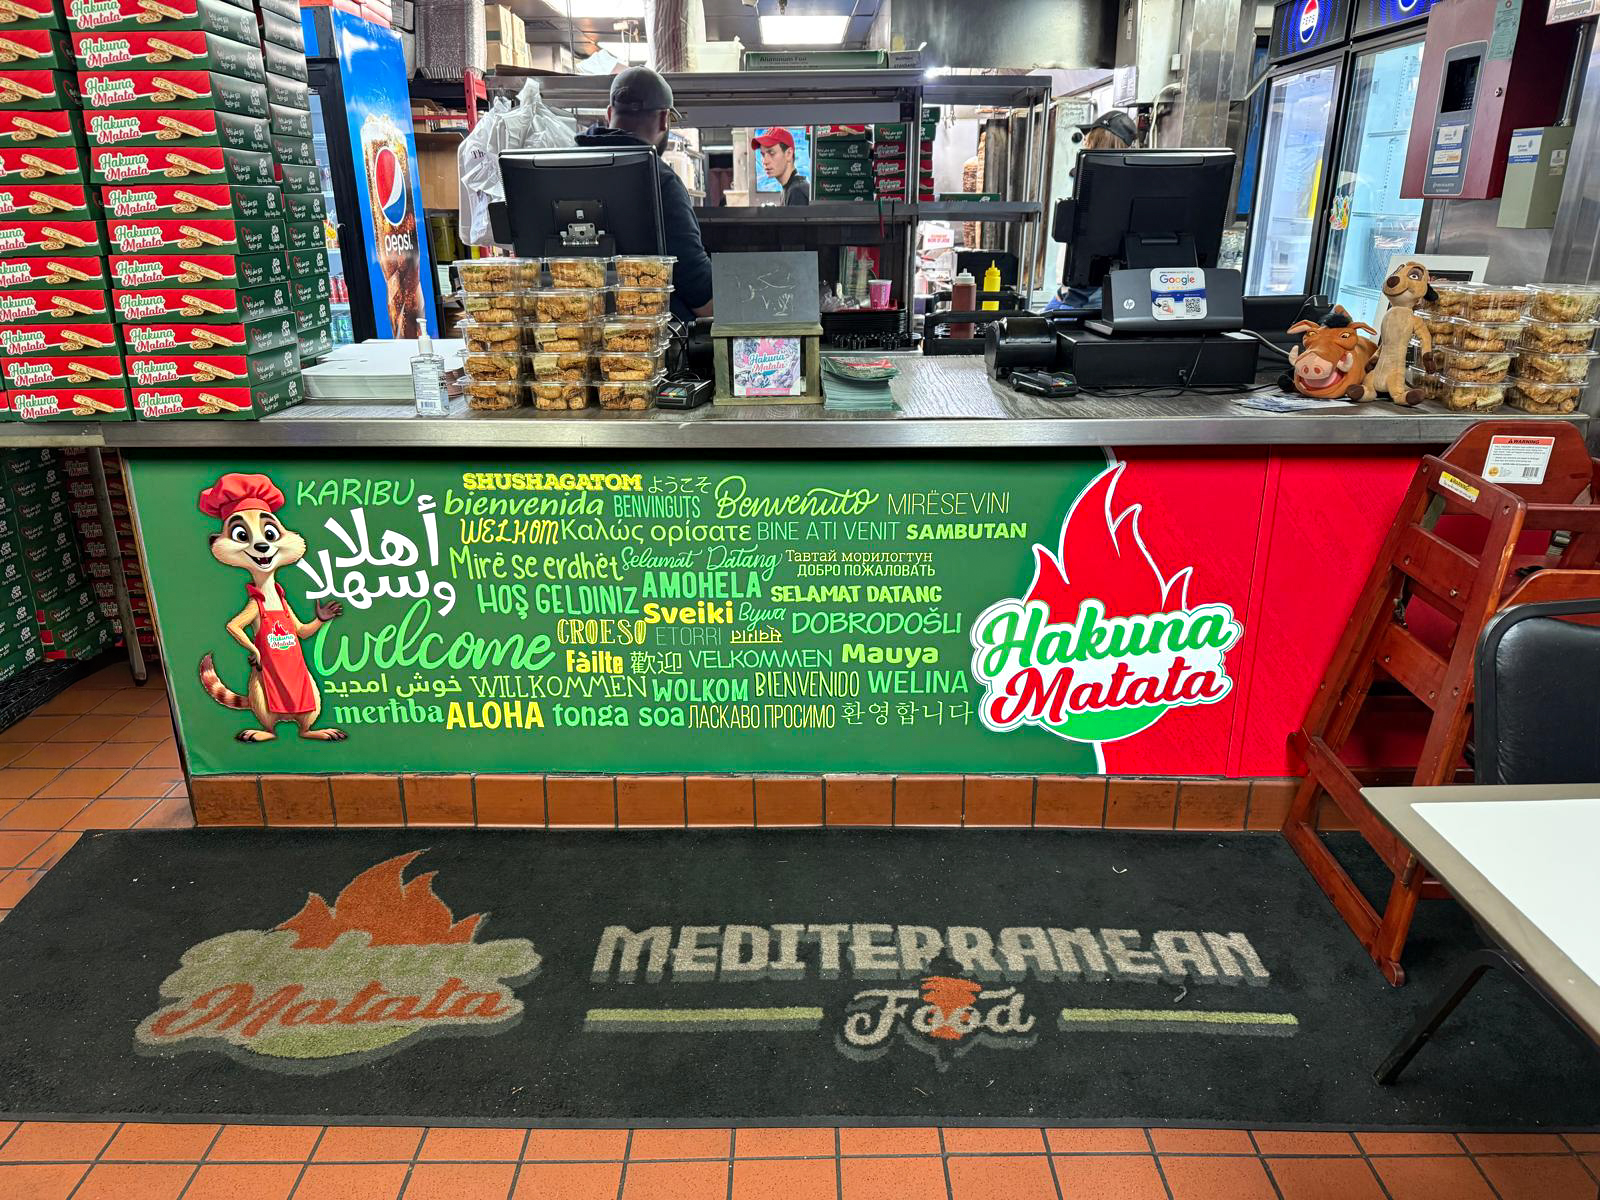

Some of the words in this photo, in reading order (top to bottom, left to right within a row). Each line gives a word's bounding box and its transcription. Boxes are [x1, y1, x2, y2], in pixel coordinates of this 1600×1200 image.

[71, 0, 118, 17] Hakuna
[78, 12, 121, 28] Matata
[80, 39, 128, 55] Hakuna
[88, 51, 130, 68] Matata
[86, 78, 134, 95] Hakuna
[92, 90, 136, 106] Matata
[92, 116, 138, 132] Hakuna
[98, 128, 140, 144] Matata
[100, 154, 146, 169] Hakuna
[106, 166, 149, 180] Matata
[109, 190, 156, 206] Hakuna
[115, 202, 157, 216] Matata
[115, 226, 160, 241] Hakuna
[384, 230, 410, 256] pepsi
[121, 238, 164, 252] Matata
[117, 261, 162, 276] Hakuna
[122, 272, 164, 286] Matata
[1160, 274, 1196, 286] Google
[120, 295, 164, 310] Hakuna
[126, 306, 166, 320] Matata
[2, 330, 44, 344] Hakuna
[130, 328, 174, 343] Hakuna
[8, 342, 46, 354] Matata
[136, 339, 176, 352] Matata
[750, 353, 785, 364] Hakuna
[9, 362, 51, 377] Hakuna
[133, 362, 176, 376] Hakuna
[138, 372, 178, 385] Matata
[16, 374, 54, 386] Matata
[14, 395, 57, 409] Hakuna
[138, 394, 182, 408] Hakuna
[22, 406, 59, 419] Matata
[144, 404, 183, 418] Matata
[463, 472, 642, 492] SHUSHAGATOM
[648, 476, 712, 494] ようこそ
[296, 478, 416, 506] KARIBU
[714, 476, 880, 518] Benvenuto
[444, 488, 604, 516] bienvenida
[614, 495, 701, 518] BENVINGUTS
[888, 490, 1010, 516] MIRËSEVINI
[324, 494, 440, 568] أهلا
[460, 518, 560, 545] WELKOM
[561, 519, 644, 544] Καλώς
[650, 520, 752, 546] ορίσατε
[757, 522, 800, 541] BINE
[806, 522, 836, 540] ATI
[842, 521, 900, 540] VENIT
[906, 522, 1028, 540] SAMBUTAN
[449, 545, 508, 580] Mirë
[511, 554, 538, 578] se
[543, 551, 624, 580] erdhët
[620, 546, 702, 571] Selamat
[706, 544, 783, 582] Datang
[785, 549, 837, 562] Тавтай
[842, 552, 933, 566] морилогтун
[796, 564, 841, 578] ДОБРО
[844, 564, 936, 577] ПОЖАЛОВАТЬ
[296, 549, 456, 617] وسهلا
[642, 572, 762, 599] AMOHELA
[476, 583, 529, 620] HOŞ
[535, 584, 638, 615] GELDINIZ
[770, 585, 862, 604] SELAMAT
[867, 585, 942, 604] DATANG
[643, 600, 734, 625] Sveiki
[738, 602, 786, 631] Bywa
[792, 607, 962, 635] DOBRODOŠLI
[556, 618, 647, 646] CROESO
[656, 626, 722, 646] ETORRI
[982, 606, 1232, 678] Hakuna
[566, 650, 624, 674] Fàilte
[630, 650, 684, 675] 歡迎
[688, 650, 833, 669] VELKOMMEN
[842, 643, 939, 668] Mauya
[324, 672, 388, 698] امديد
[396, 672, 462, 698] خوش
[468, 675, 647, 698] WILLKOMMEN
[652, 678, 749, 704] WOLKOM
[754, 670, 860, 698] BIENVENIDO
[868, 670, 968, 694] WELINA
[990, 656, 1224, 724] Matata
[446, 701, 545, 730] ALOHA
[552, 703, 629, 727] tonga
[638, 706, 685, 727] soa
[688, 704, 760, 729] ЛАСКАВО
[764, 704, 836, 729] ПРОСИМО
[152, 977, 510, 1038] Matata
[844, 987, 1035, 1046] Food
